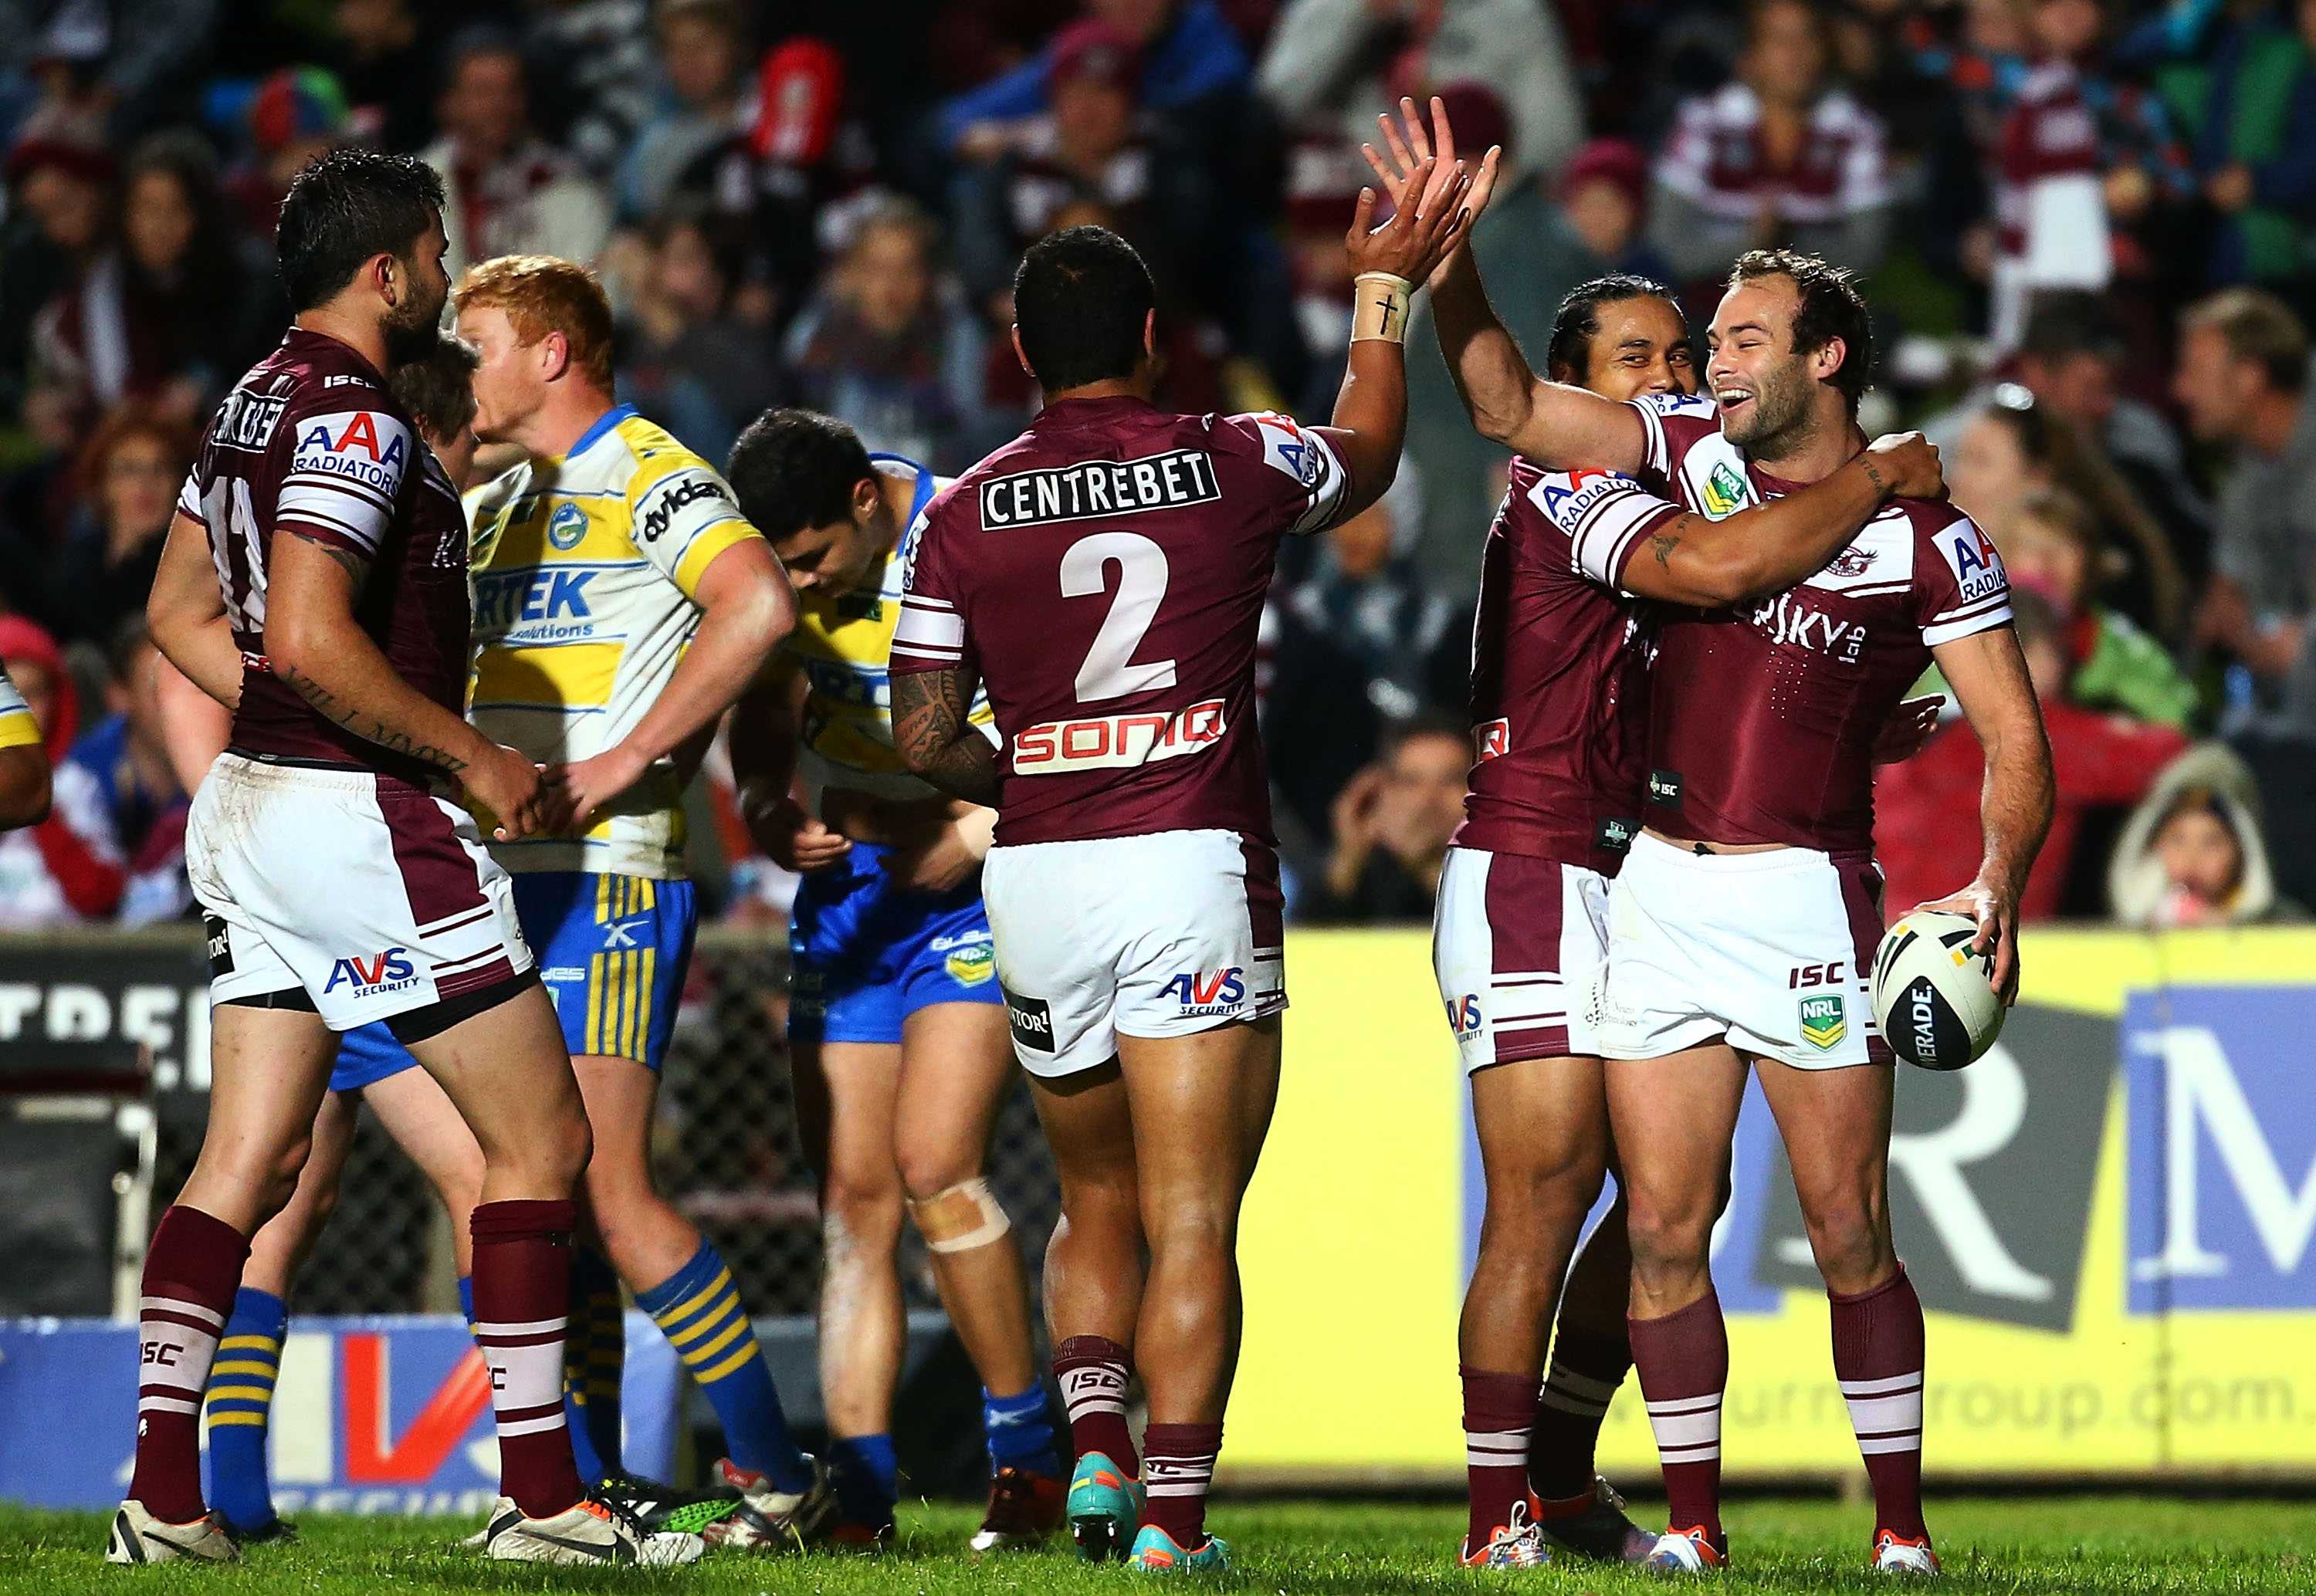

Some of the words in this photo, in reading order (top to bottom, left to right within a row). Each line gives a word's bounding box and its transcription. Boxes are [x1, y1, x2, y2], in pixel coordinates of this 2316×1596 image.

[298, 412, 404, 480] AAA
[296, 456, 399, 498] RADIATORS
[986, 451, 1208, 524] CENTREBET
[1060, 532, 1177, 703] 2
[323, 947, 415, 994] AVS
[354, 976, 419, 999] SECURITY
[1156, 966, 1245, 1004] AVS
[1789, 962, 1844, 989] ISC
[1802, 999, 1841, 1019] NRL
